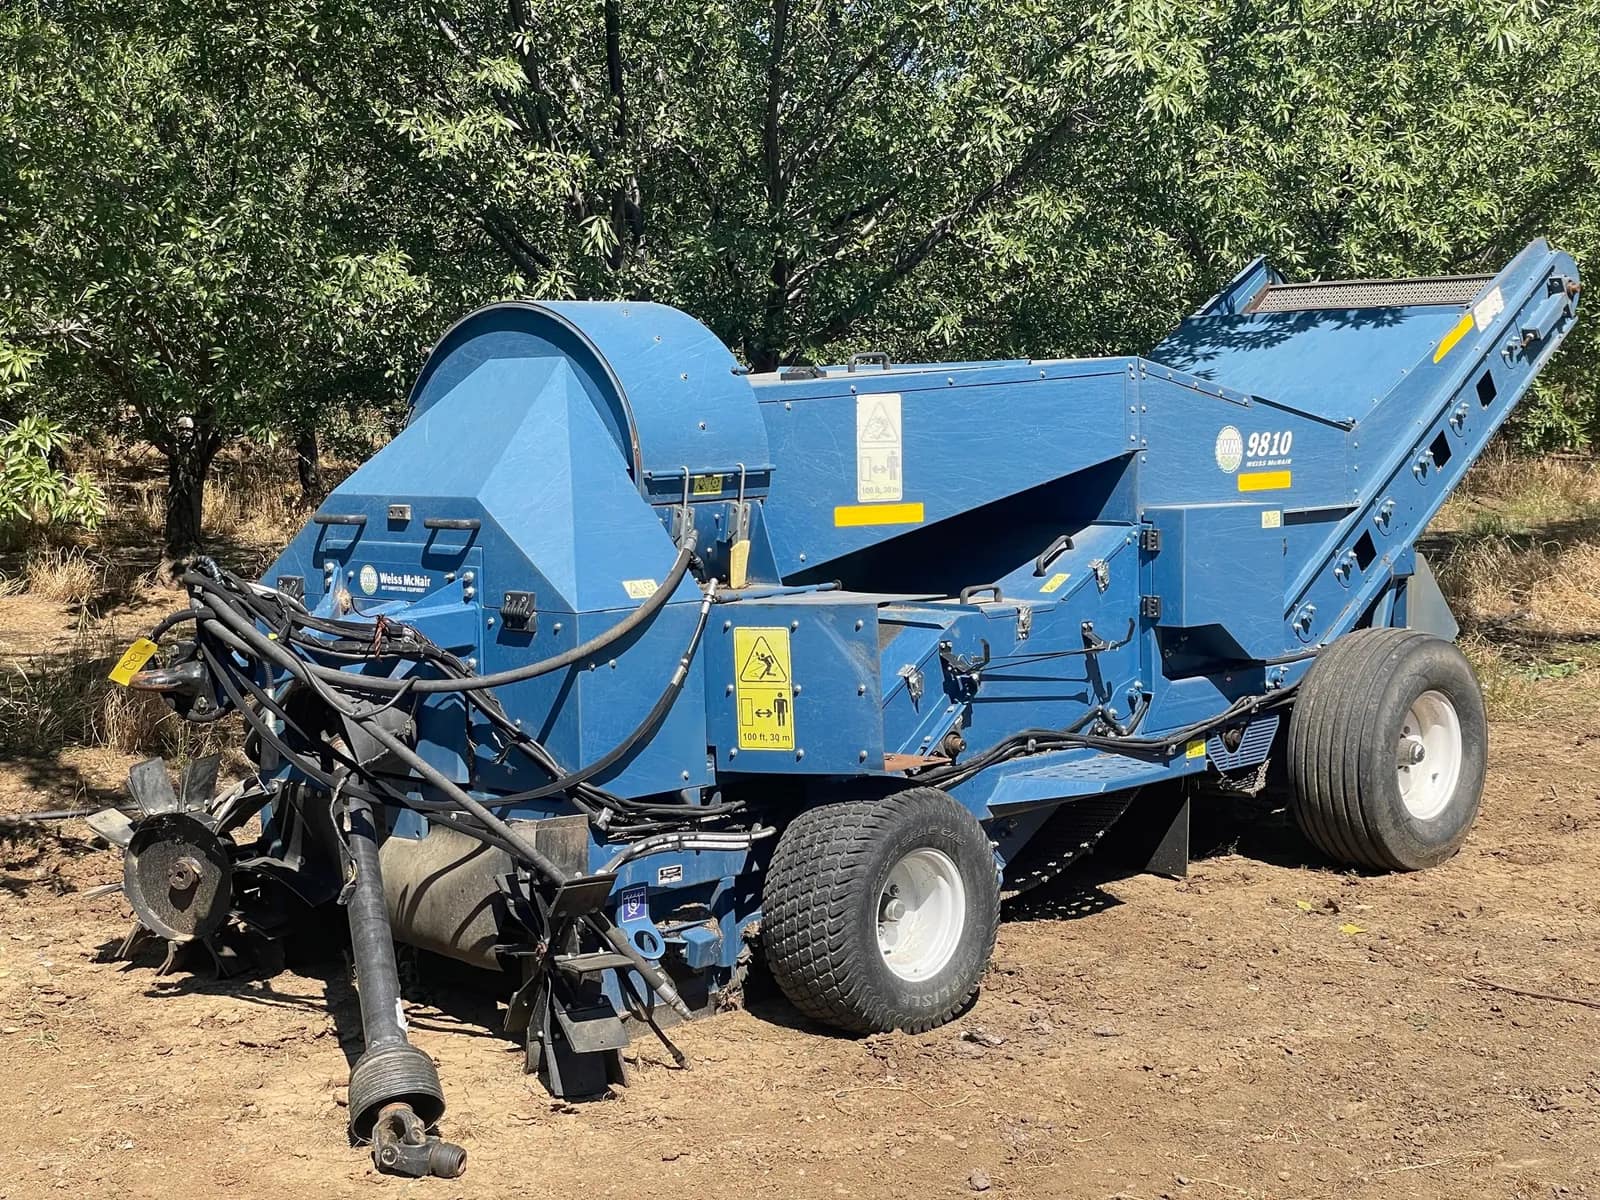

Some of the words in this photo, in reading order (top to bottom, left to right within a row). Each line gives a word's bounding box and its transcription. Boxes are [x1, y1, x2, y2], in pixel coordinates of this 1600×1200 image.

[1246, 429, 1293, 458] 9810
[379, 572, 403, 585] Weiss
[403, 574, 432, 587] McNair
[743, 732, 758, 741] 100
[769, 733, 780, 743] 30
